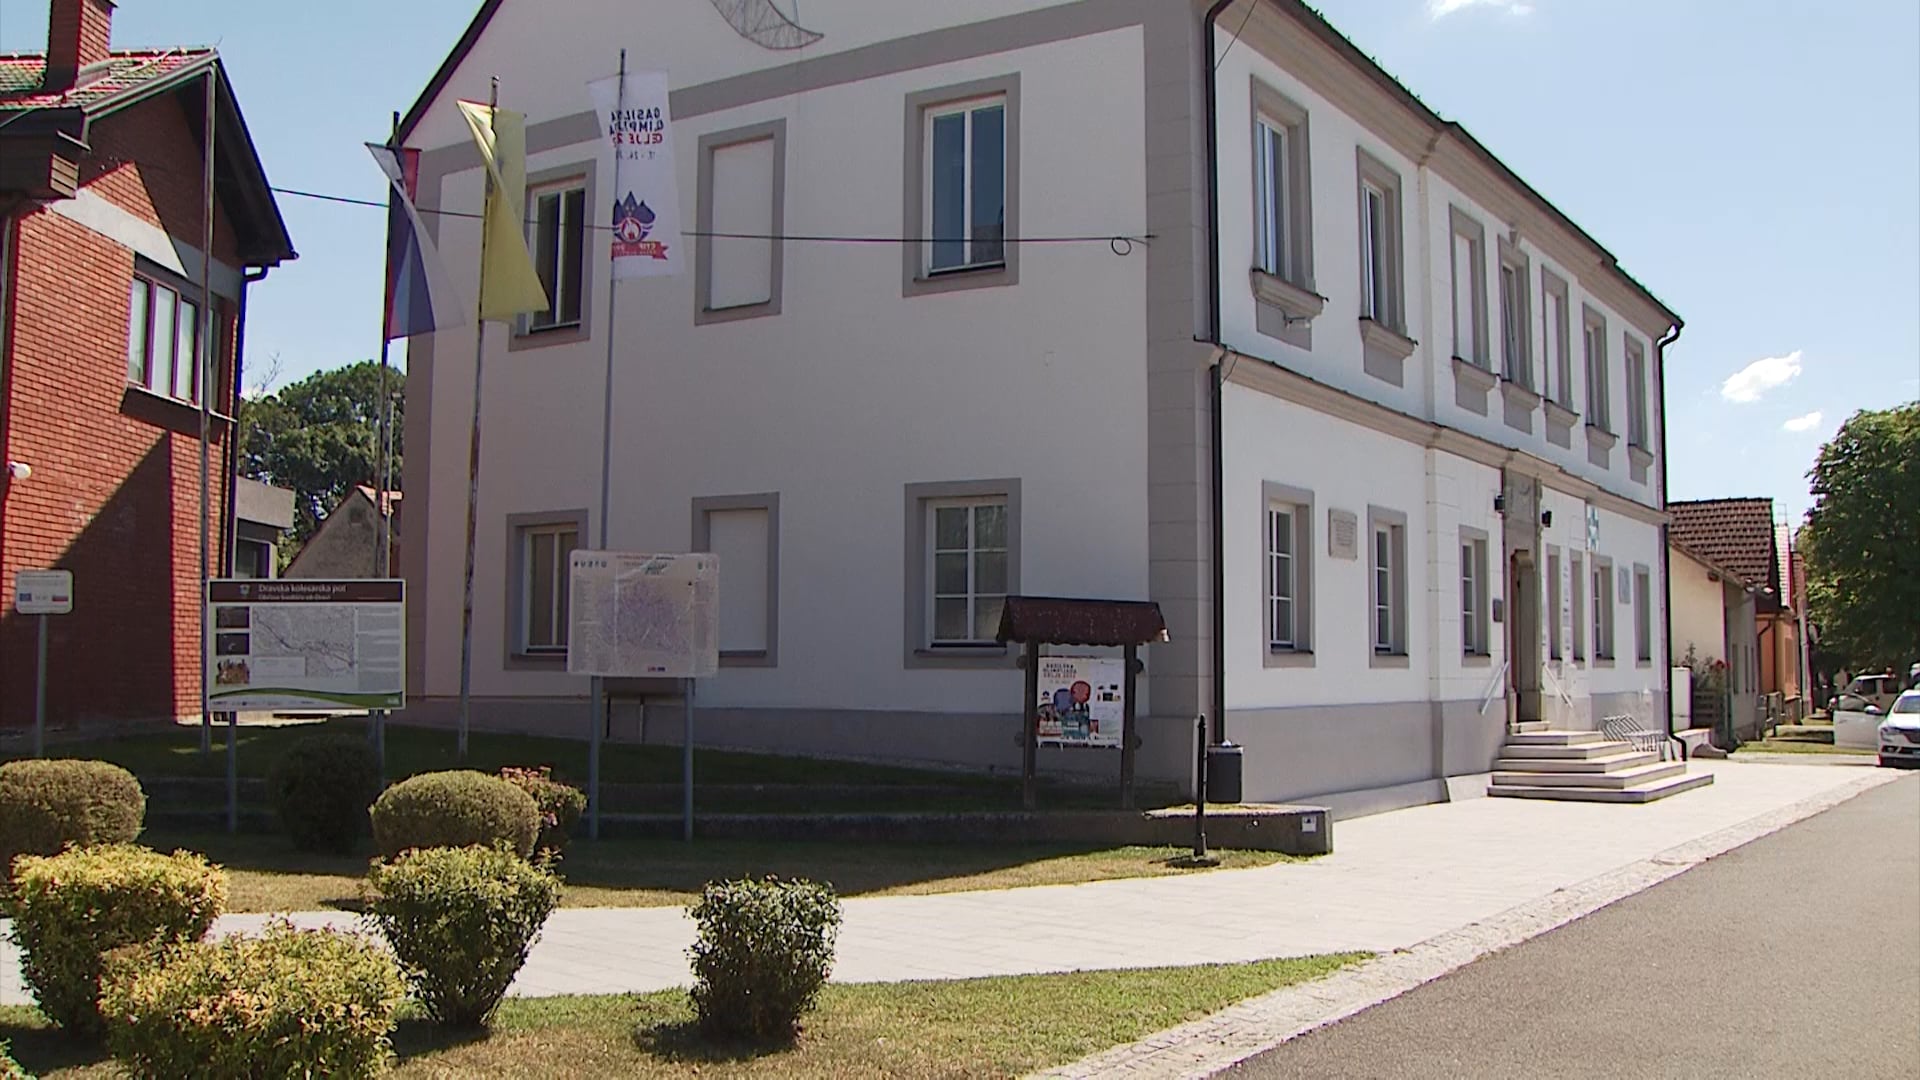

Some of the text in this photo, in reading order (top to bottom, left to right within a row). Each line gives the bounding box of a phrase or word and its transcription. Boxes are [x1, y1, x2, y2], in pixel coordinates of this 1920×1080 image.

[258, 583, 347, 594] Dravska kolesarska pot
